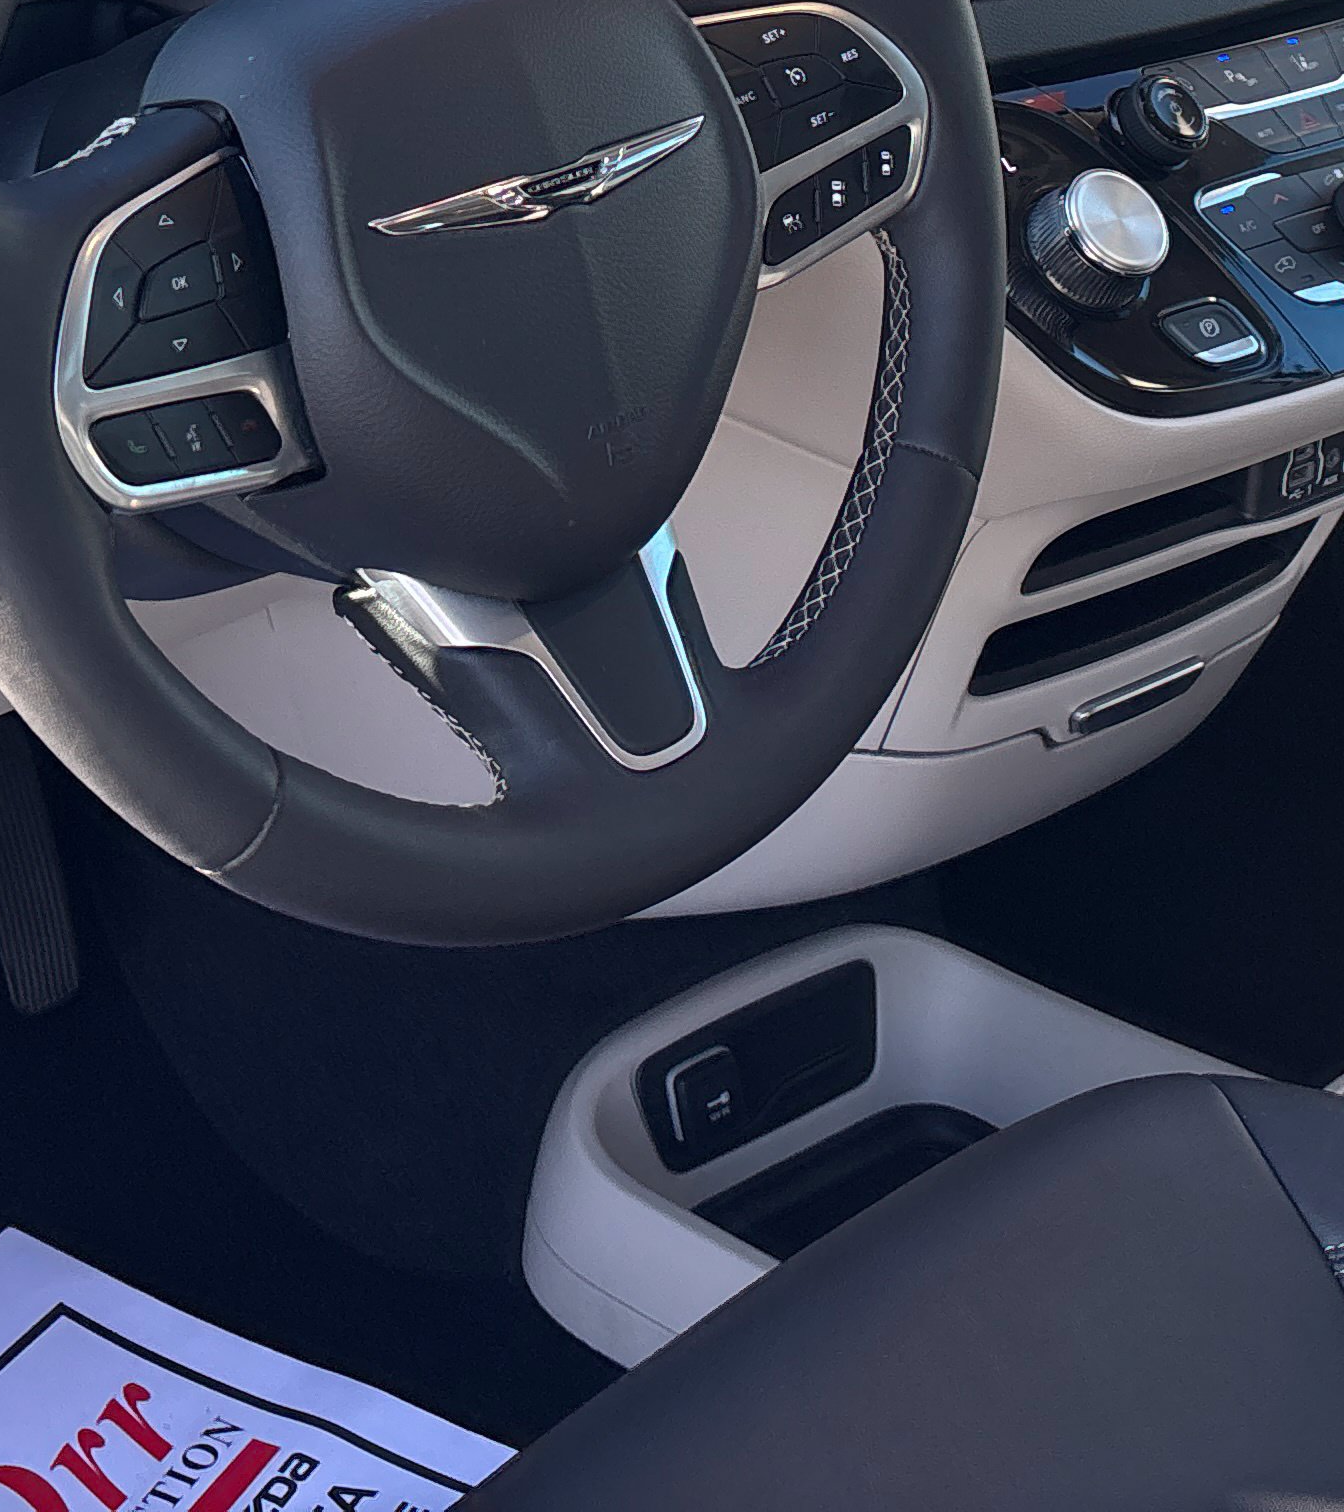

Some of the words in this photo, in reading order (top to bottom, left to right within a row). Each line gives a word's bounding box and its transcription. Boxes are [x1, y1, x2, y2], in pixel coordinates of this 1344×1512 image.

[840, 48, 859, 63] RES
[734, 91, 756, 106] ANC
[171, 275, 189, 291] OK
[129, 1414, 245, 1512] TION
